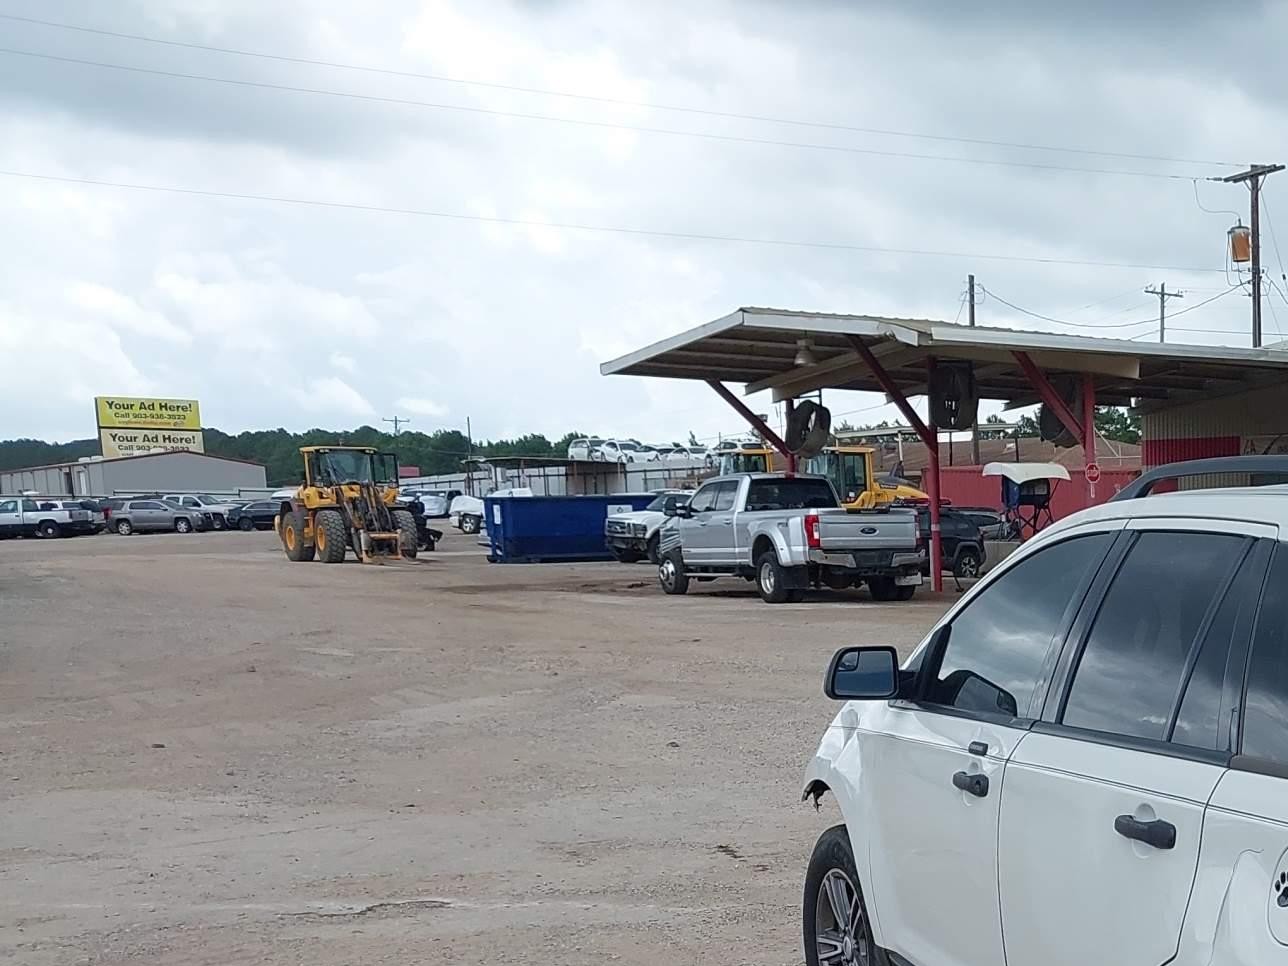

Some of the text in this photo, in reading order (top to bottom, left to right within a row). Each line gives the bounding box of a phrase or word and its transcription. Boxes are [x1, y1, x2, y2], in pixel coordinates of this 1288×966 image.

[105, 400, 193, 413] Your Ad Here!
[109, 432, 196, 444] Your Ad Here!
